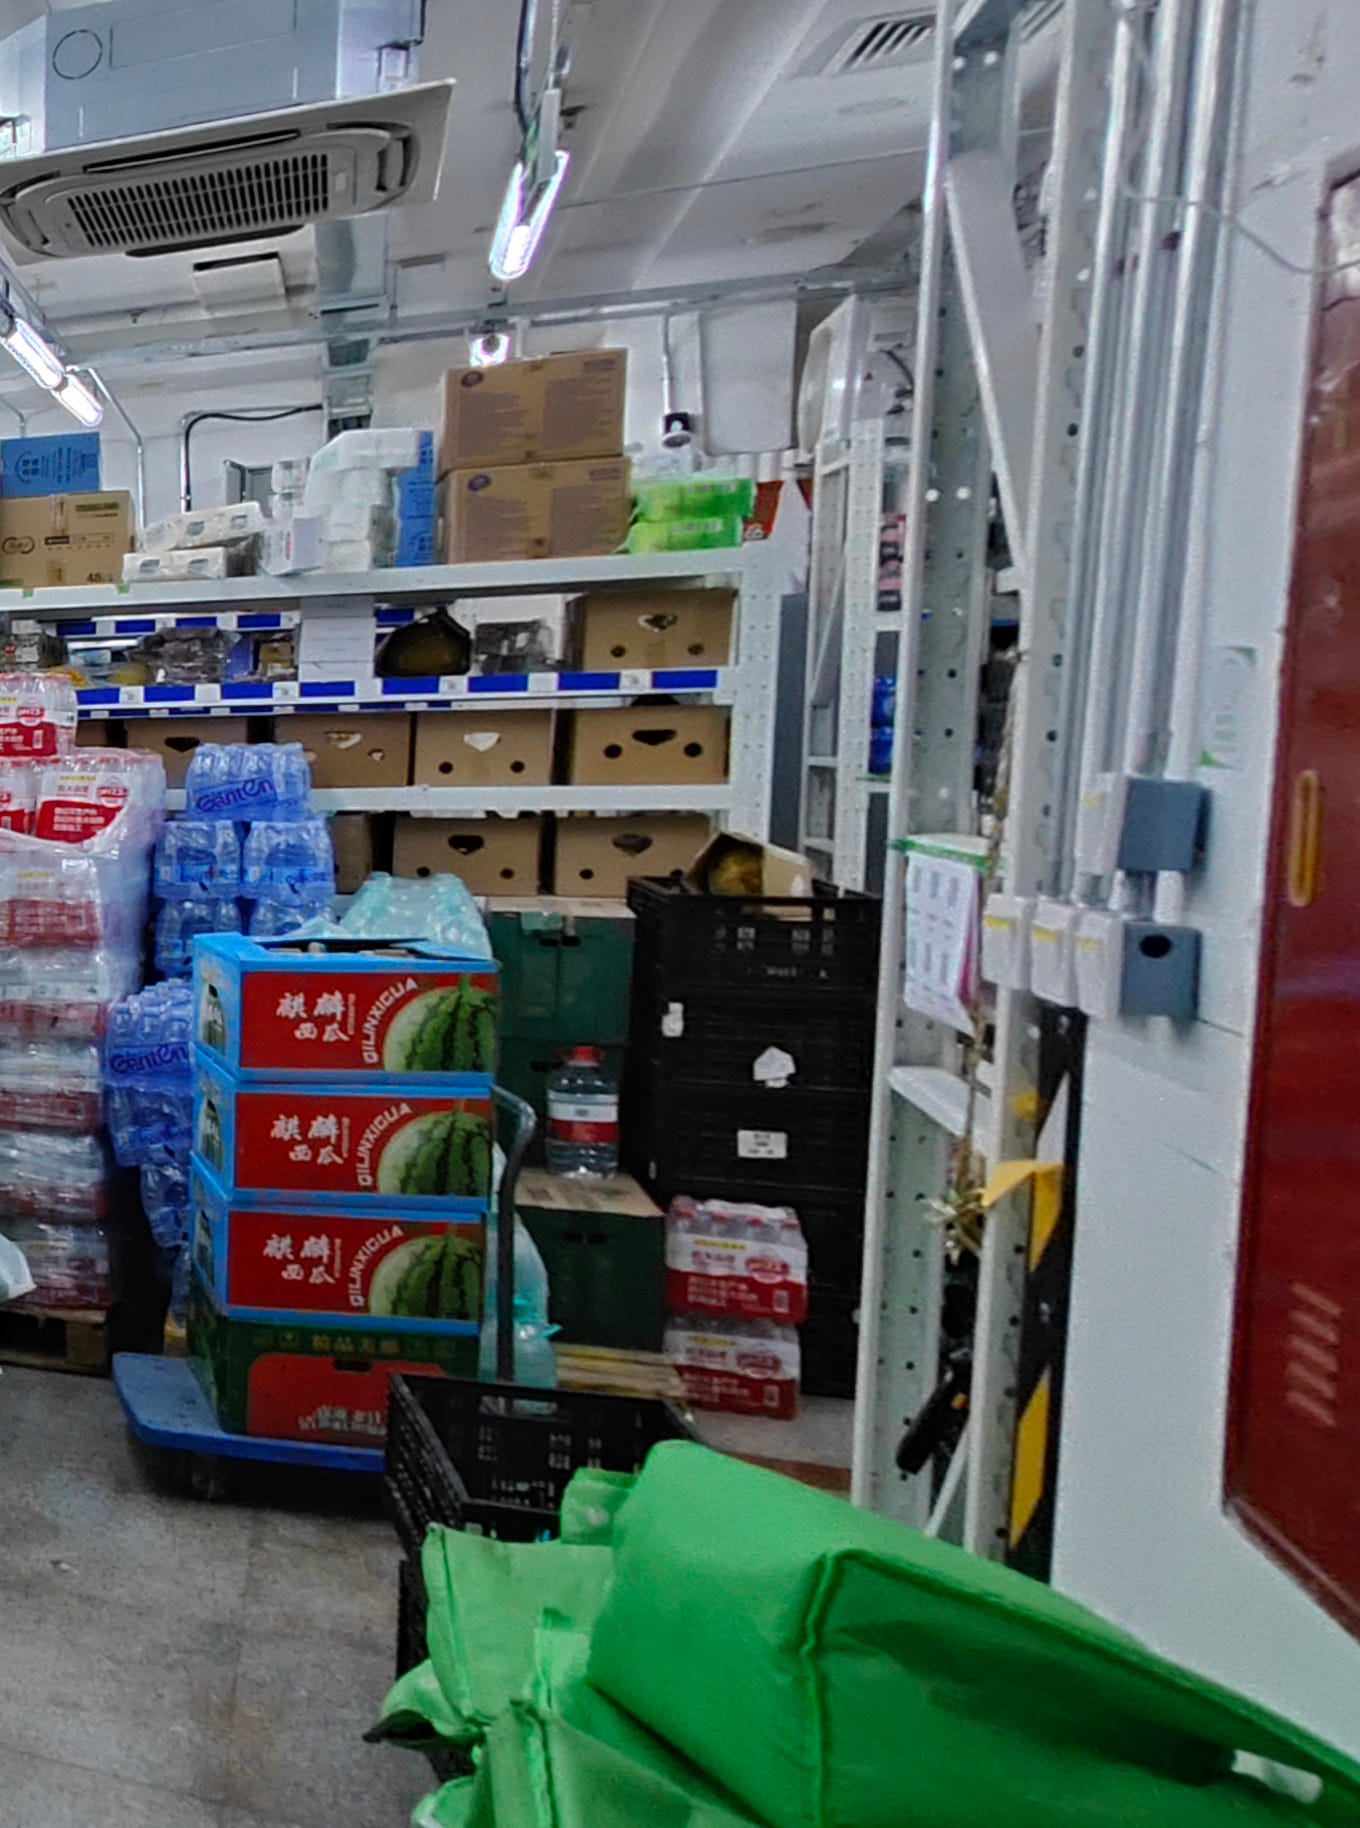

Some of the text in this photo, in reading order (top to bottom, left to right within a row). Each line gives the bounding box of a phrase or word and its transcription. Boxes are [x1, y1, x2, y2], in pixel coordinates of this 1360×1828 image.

[294, 1021, 350, 1043] 西瓜
[361, 976, 419, 1065] QILINXIGUA
[288, 1144, 345, 1166] 西瓜
[355, 1101, 413, 1187] QILINXIGUA
[281, 1263, 336, 1285] 西瓜
[349, 1224, 405, 1307] QILINXIGUA
